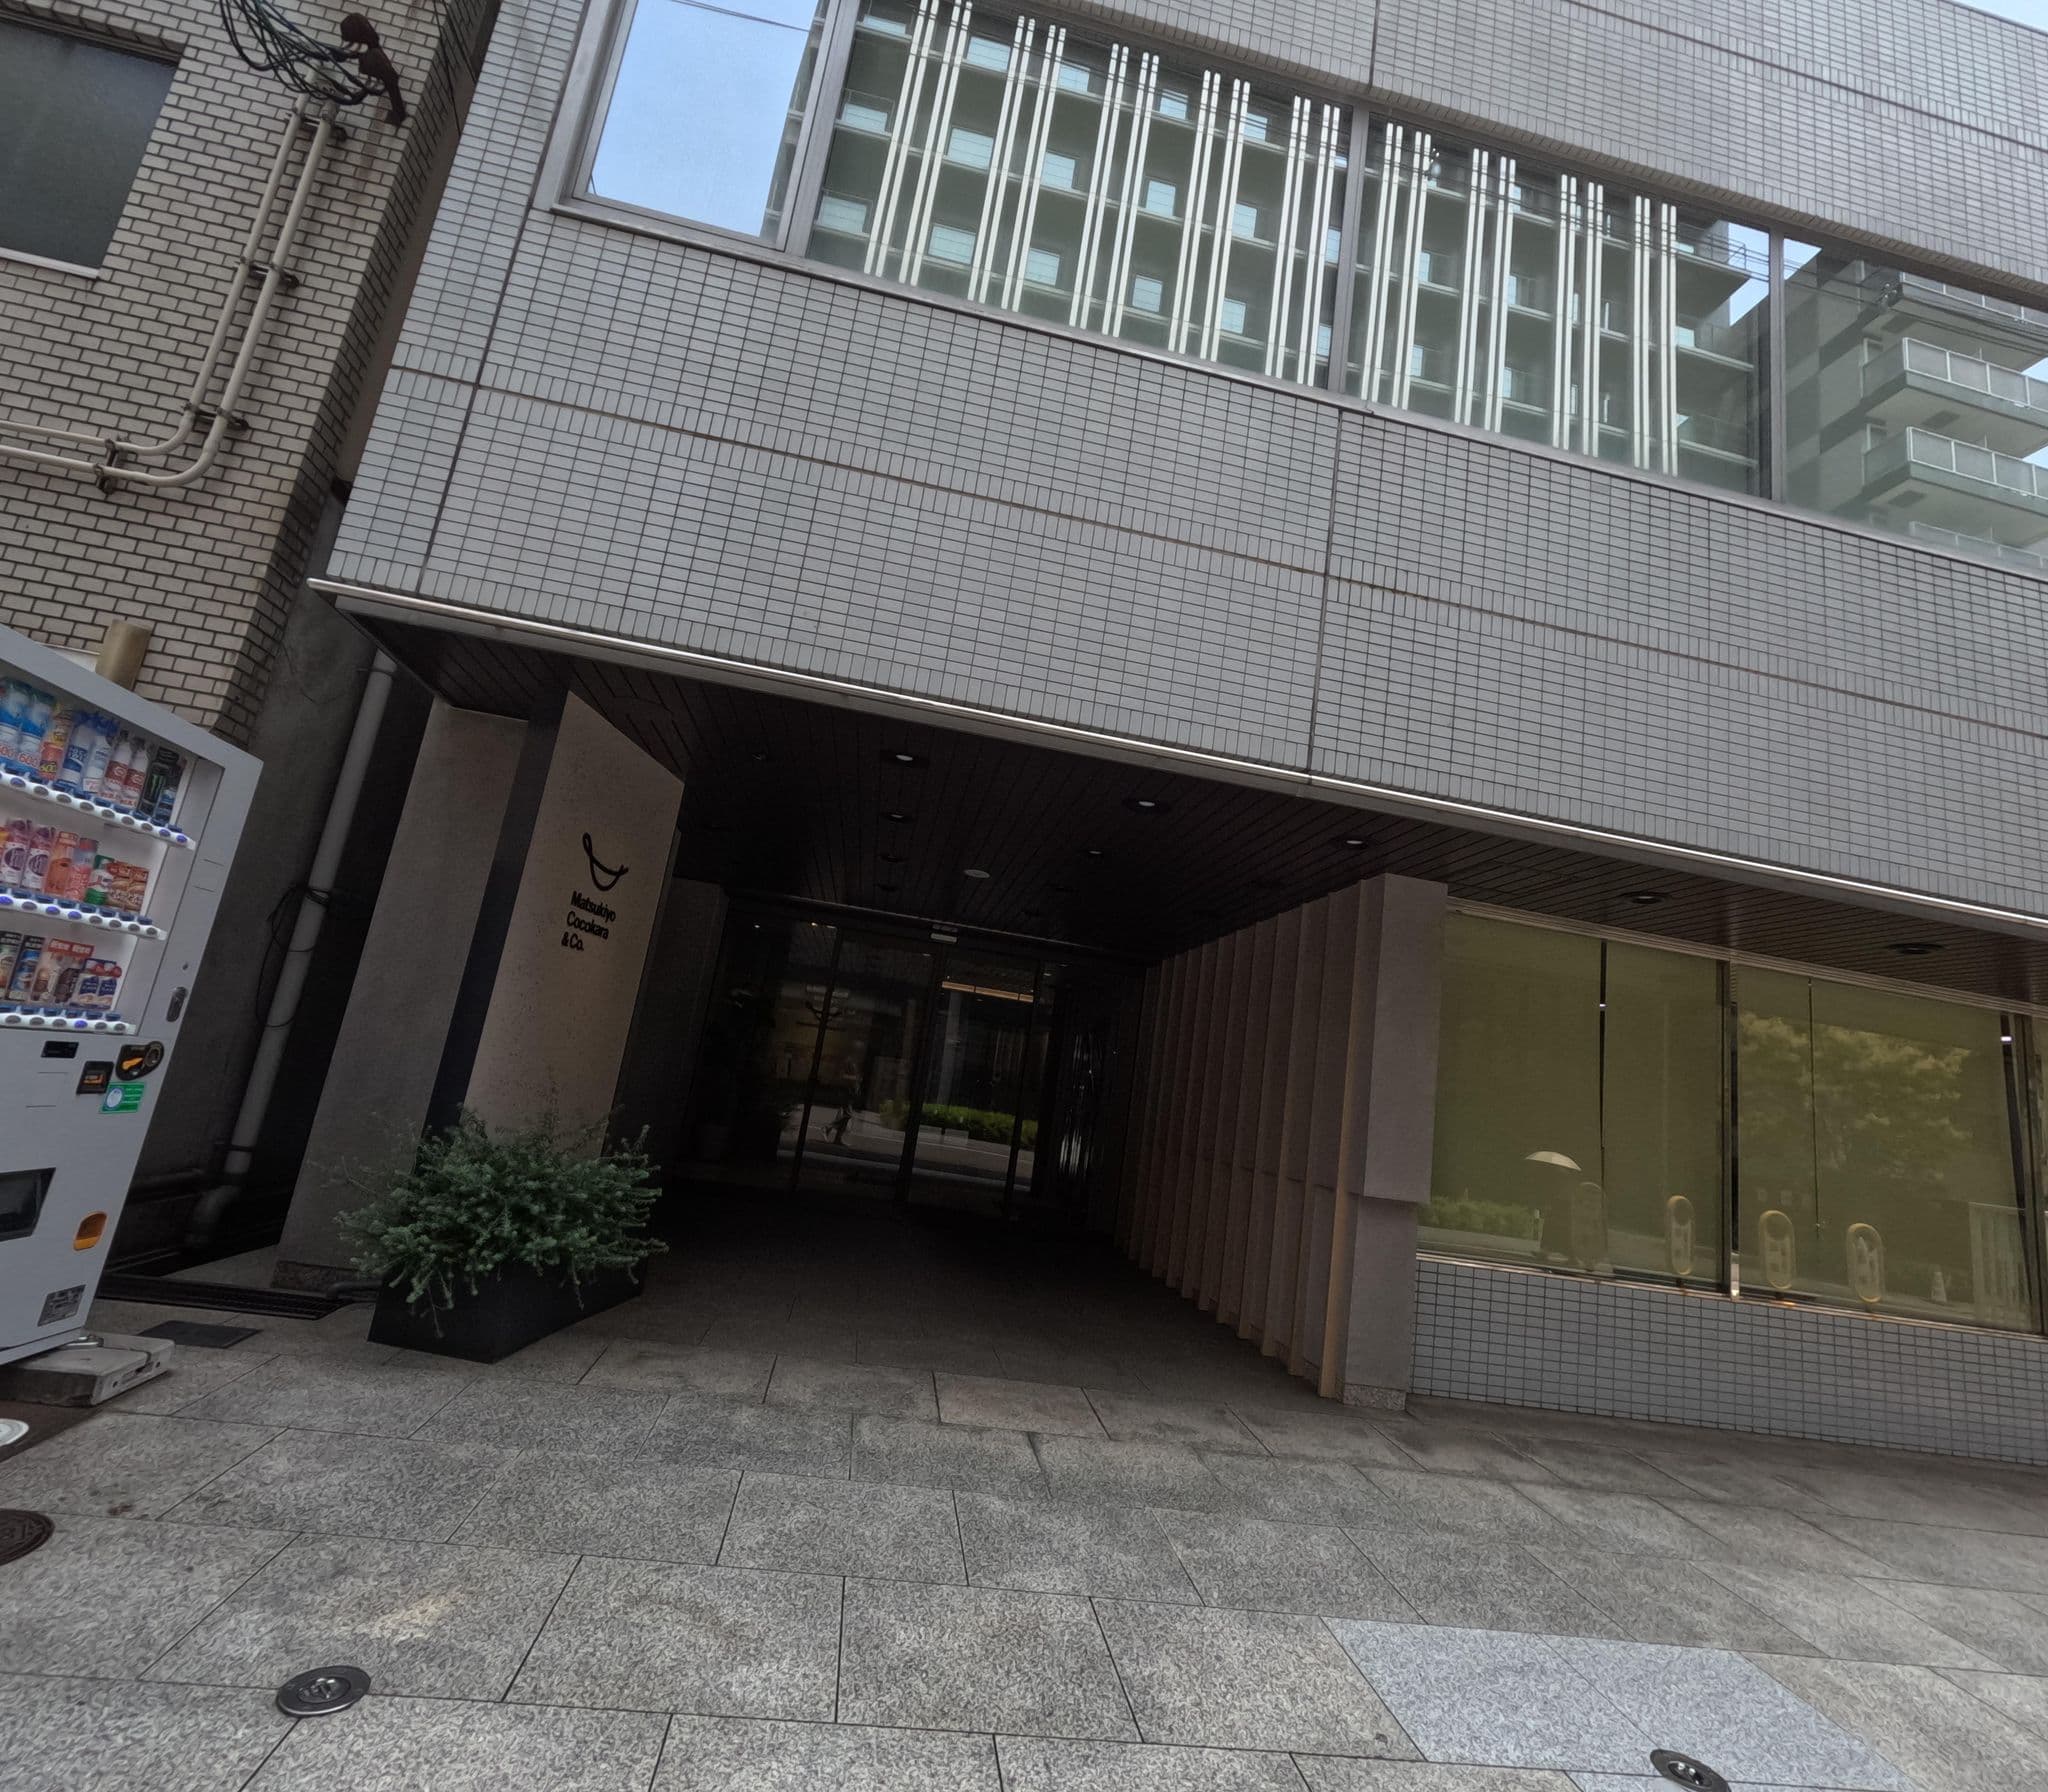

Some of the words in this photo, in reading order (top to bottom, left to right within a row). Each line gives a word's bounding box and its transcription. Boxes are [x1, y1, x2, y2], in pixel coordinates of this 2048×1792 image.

[571, 891, 616, 923] Matsukiyo
[567, 911, 610, 940] Cocokara
[561, 932, 569, 947] &
[569, 934, 585, 951] Co.
